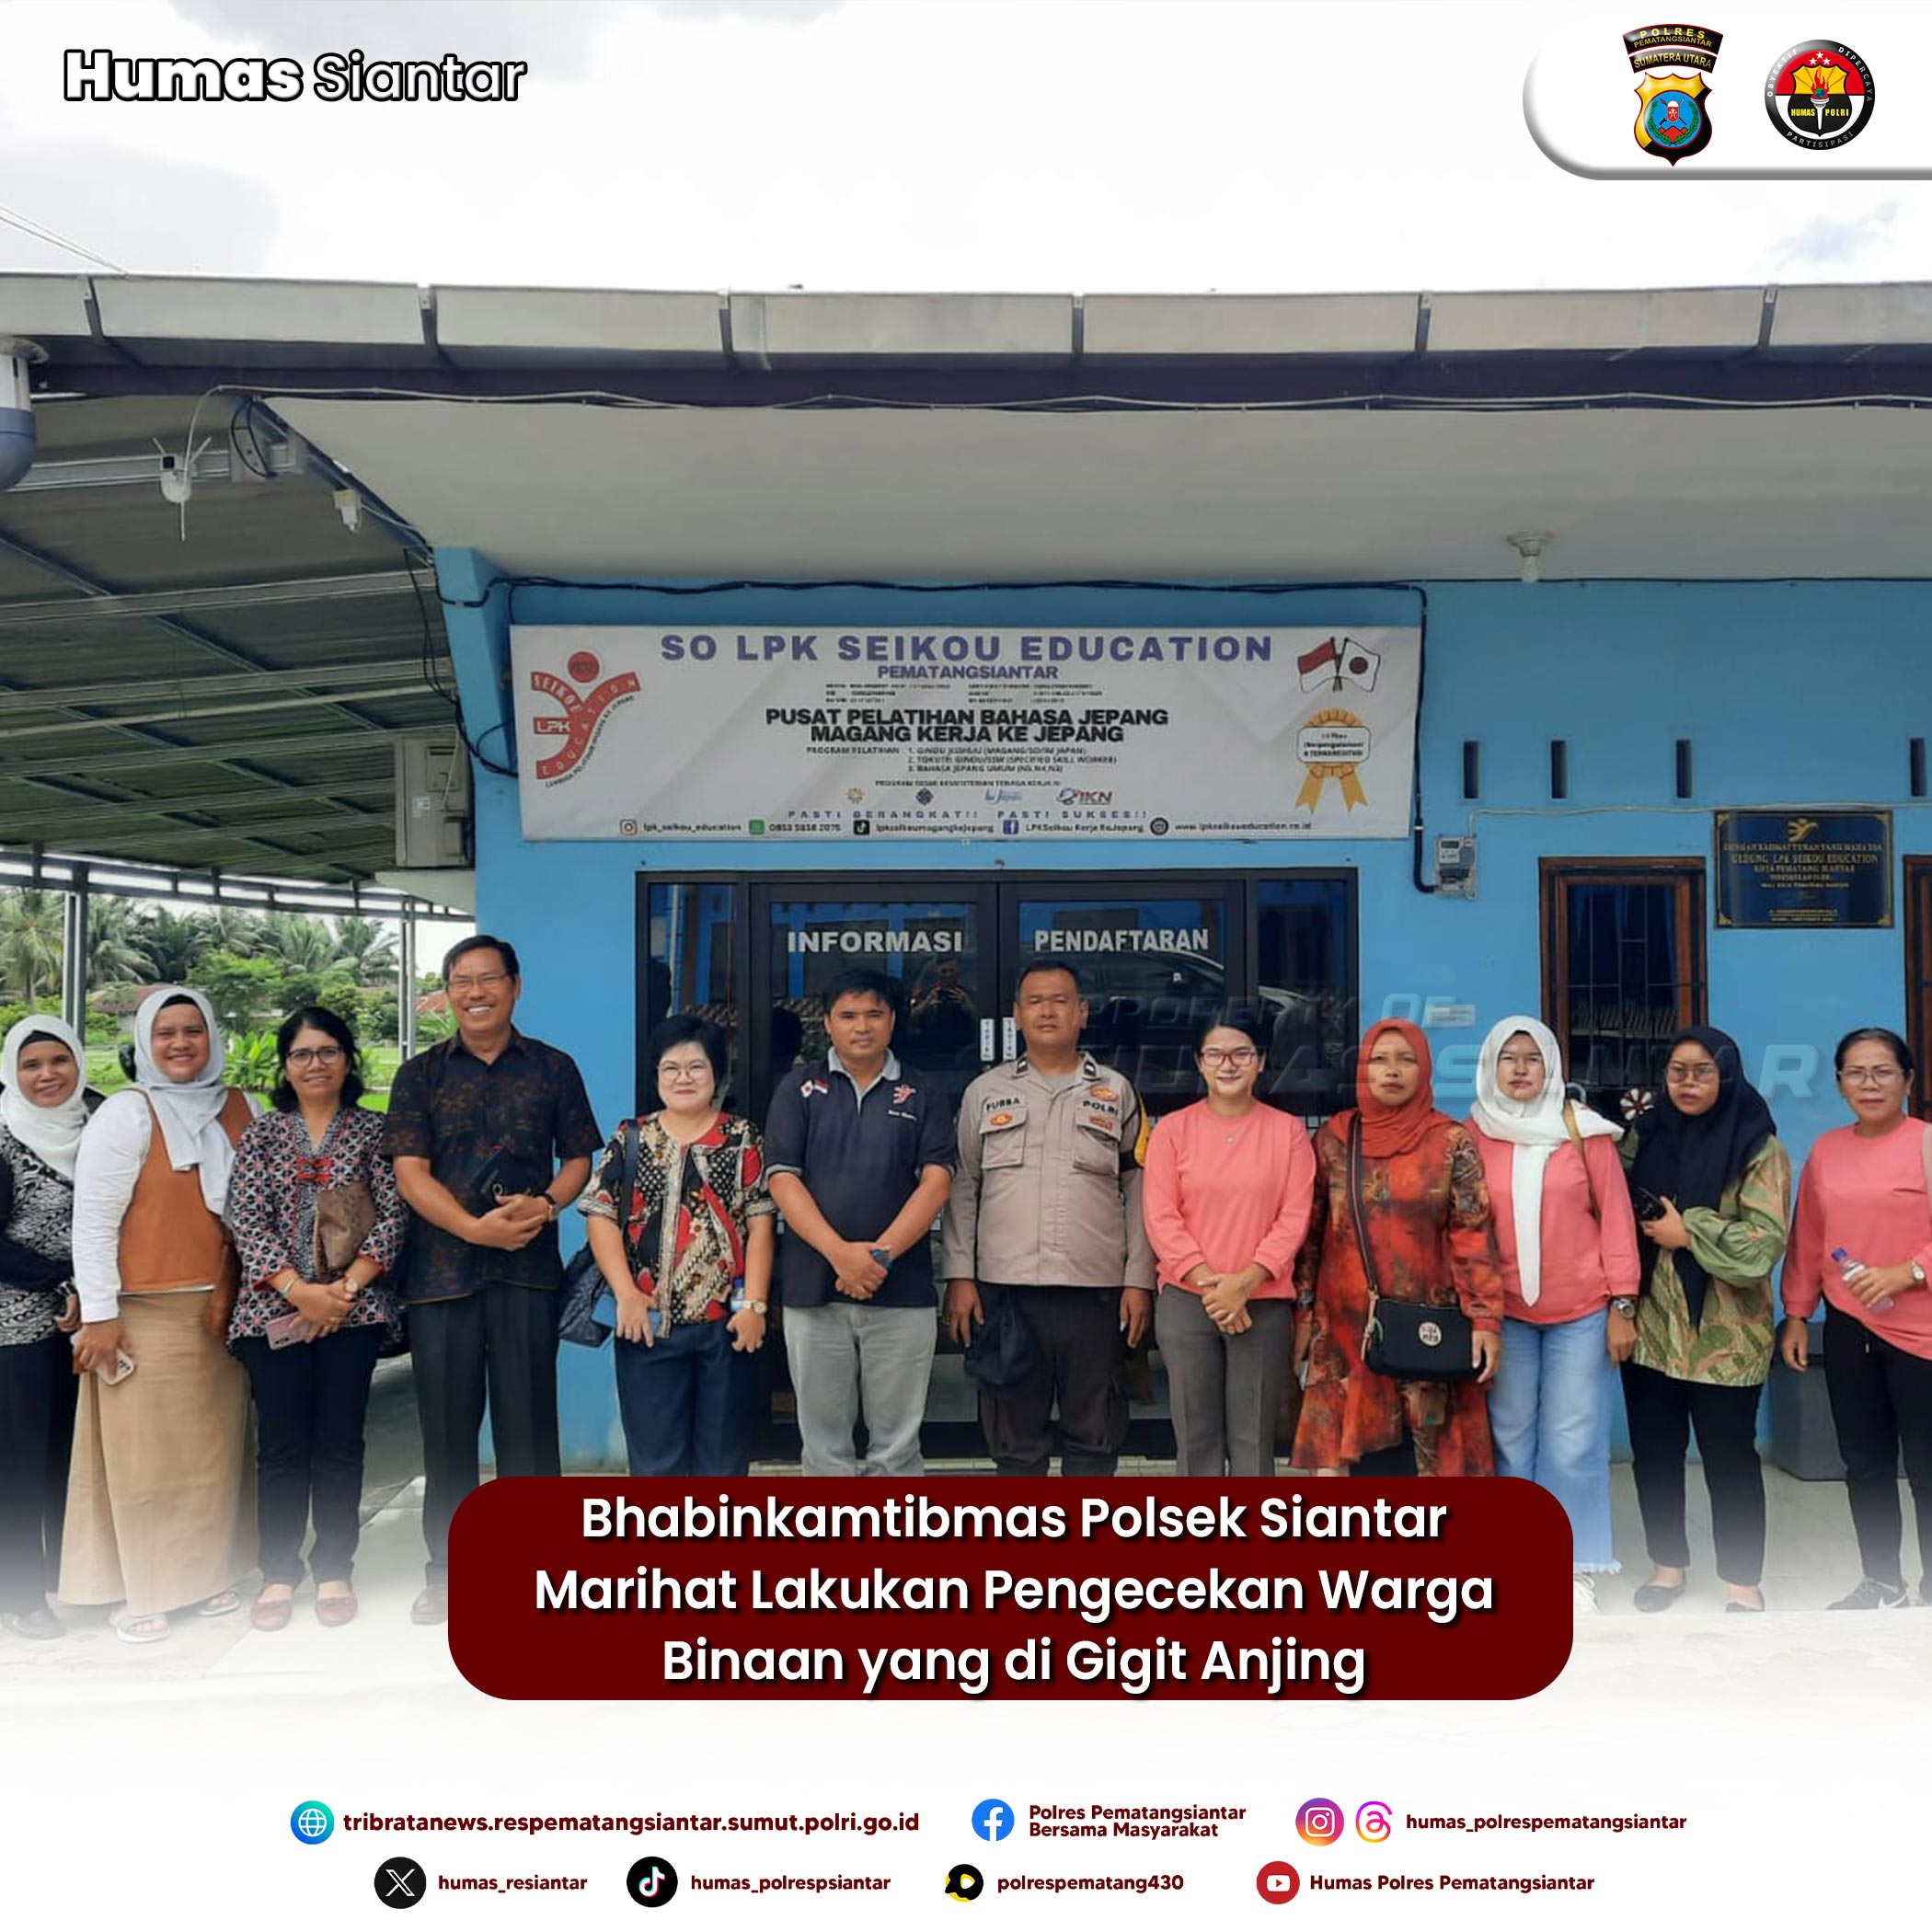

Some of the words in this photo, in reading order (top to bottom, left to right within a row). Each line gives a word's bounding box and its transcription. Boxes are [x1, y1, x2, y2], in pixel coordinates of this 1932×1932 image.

[661, 634, 717, 661] SO
[736, 635, 819, 661] LPK
[837, 635, 1001, 661] SEIKOU
[1020, 635, 1272, 662] EDUCATION
[877, 665, 1059, 680] PEMATANGSIANTAR
[765, 708, 842, 725] PUSAT
[847, 708, 975, 725] PELATIHAN
[980, 709, 1073, 725] BAHASA
[1078, 709, 1168, 726] JEPANG
[536, 721, 571, 733] LPK
[811, 726, 912, 742] MAGANG
[916, 726, 992, 742] KERJA
[997, 726, 1029, 742] KE
[1033, 727, 1124, 742] JEPANG
[787, 930, 963, 953] INFORMASI
[1034, 928, 1209, 952] PENDAFTARAN
